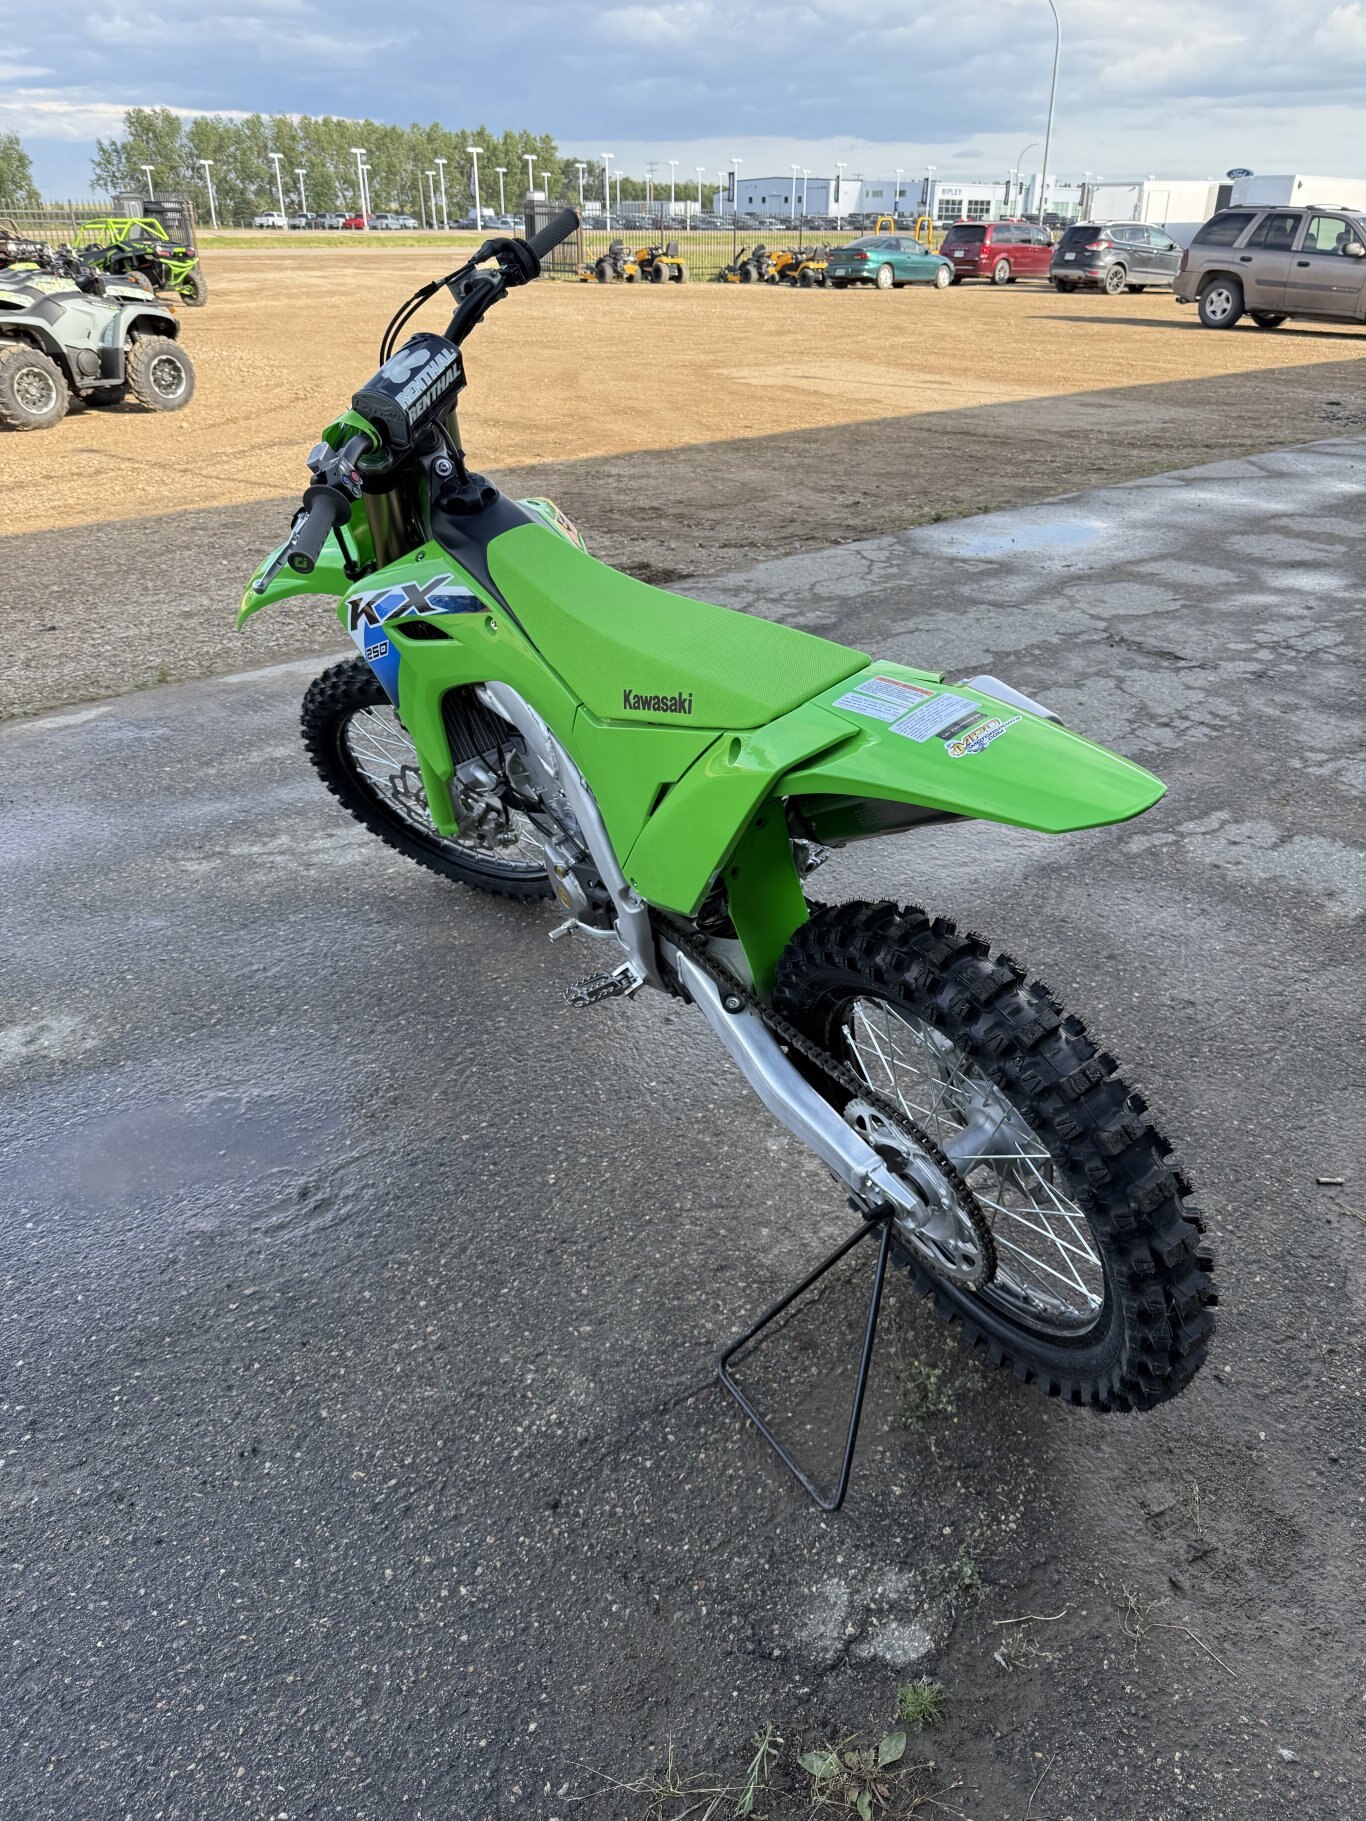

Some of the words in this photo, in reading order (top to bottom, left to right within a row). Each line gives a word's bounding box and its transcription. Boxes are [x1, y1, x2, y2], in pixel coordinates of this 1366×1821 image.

[395, 348, 458, 409] RENTHAL
[408, 363, 461, 426] RENTHAL
[346, 574, 453, 631] KX
[366, 641, 389, 660] 250
[623, 689, 693, 714] Kawasaki
[951, 719, 1000, 755] MPD
